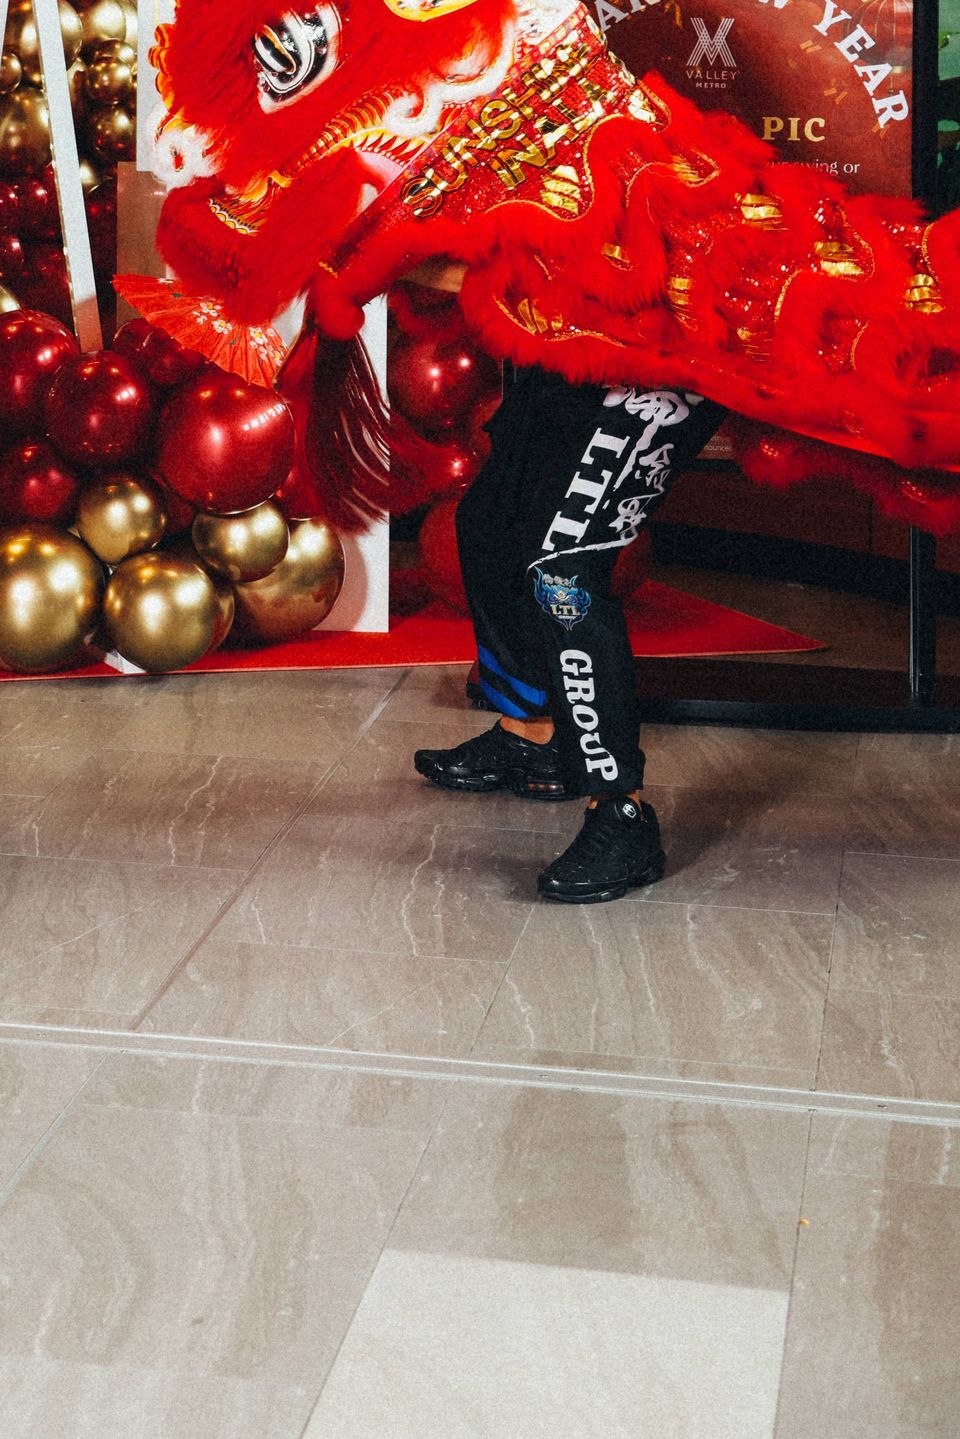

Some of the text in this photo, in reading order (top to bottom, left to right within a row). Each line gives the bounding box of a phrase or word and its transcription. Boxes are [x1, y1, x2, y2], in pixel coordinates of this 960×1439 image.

[686, 70, 737, 80] VALLEY
[761, 116, 826, 143] PIC
[843, 162, 861, 174] or
[541, 427, 630, 552] LTL
[550, 604, 581, 616] LTL
[559, 649, 619, 781] GROUP
